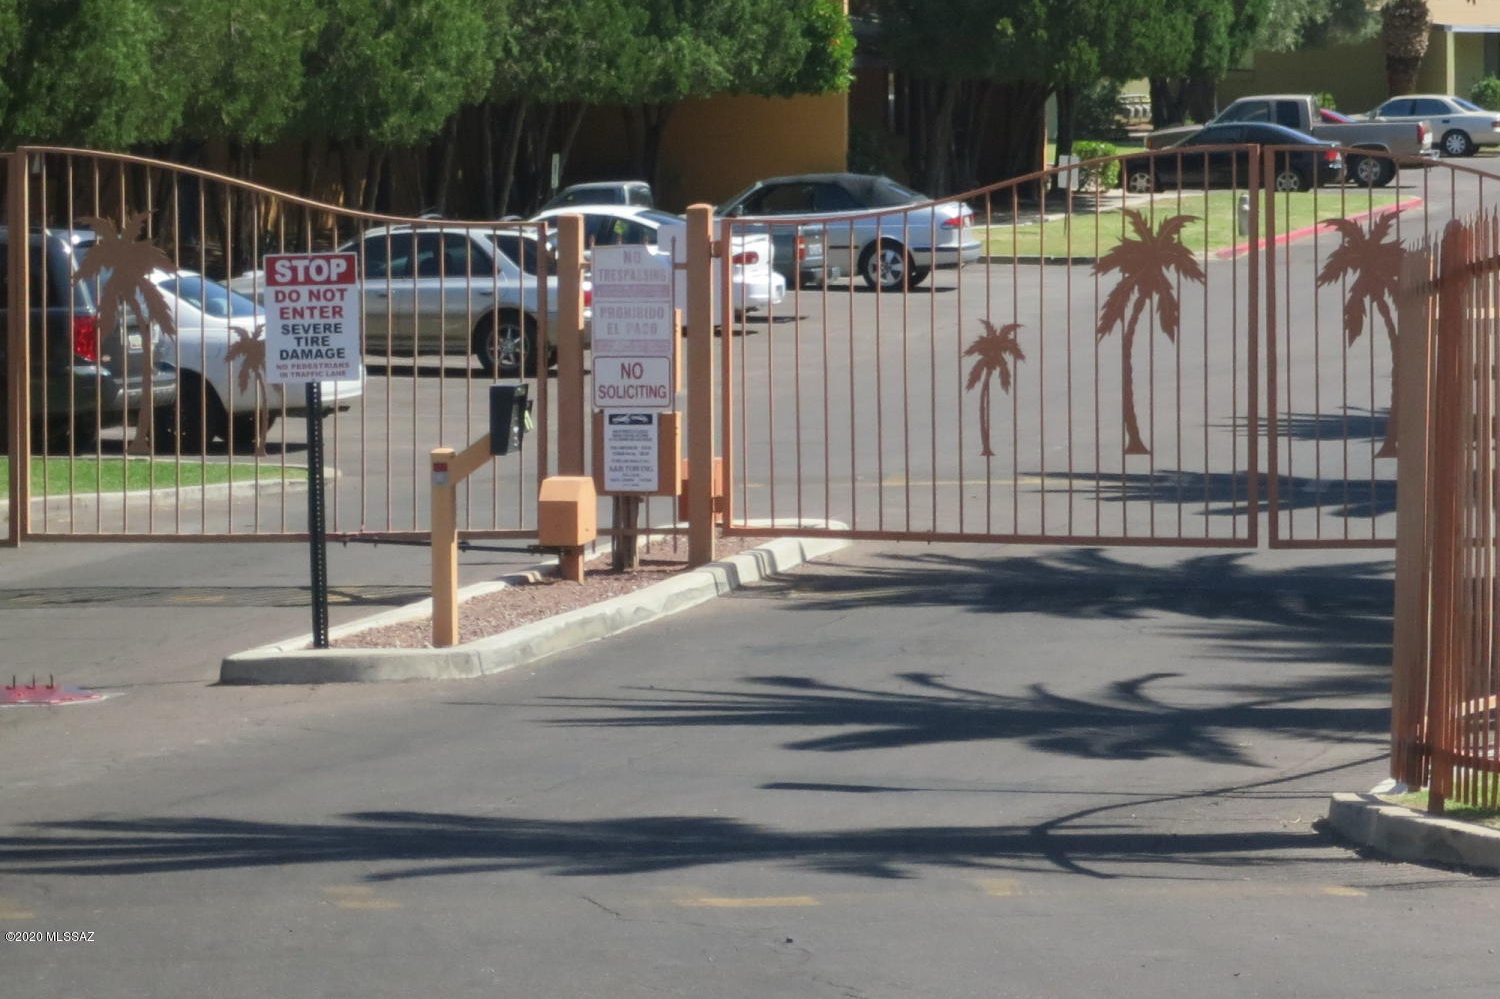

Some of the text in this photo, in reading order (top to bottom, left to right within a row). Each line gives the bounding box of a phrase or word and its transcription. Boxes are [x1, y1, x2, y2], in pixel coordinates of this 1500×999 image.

[623, 250, 641, 264] NO
[274, 258, 347, 283] STOP
[274, 288, 348, 303] DO NOT
[279, 305, 344, 320] ENTER
[600, 306, 664, 319] PROHIBIDO
[281, 323, 343, 335] SEVERE
[607, 322, 619, 335] EL
[294, 336, 330, 347] TIRE
[279, 348, 346, 361] DAMAGE
[291, 362, 349, 370] PEDESTRIANS
[620, 362, 643, 379] NO
[291, 370, 324, 378] TRAFFIC
[598, 385, 667, 399] SOLICITING
